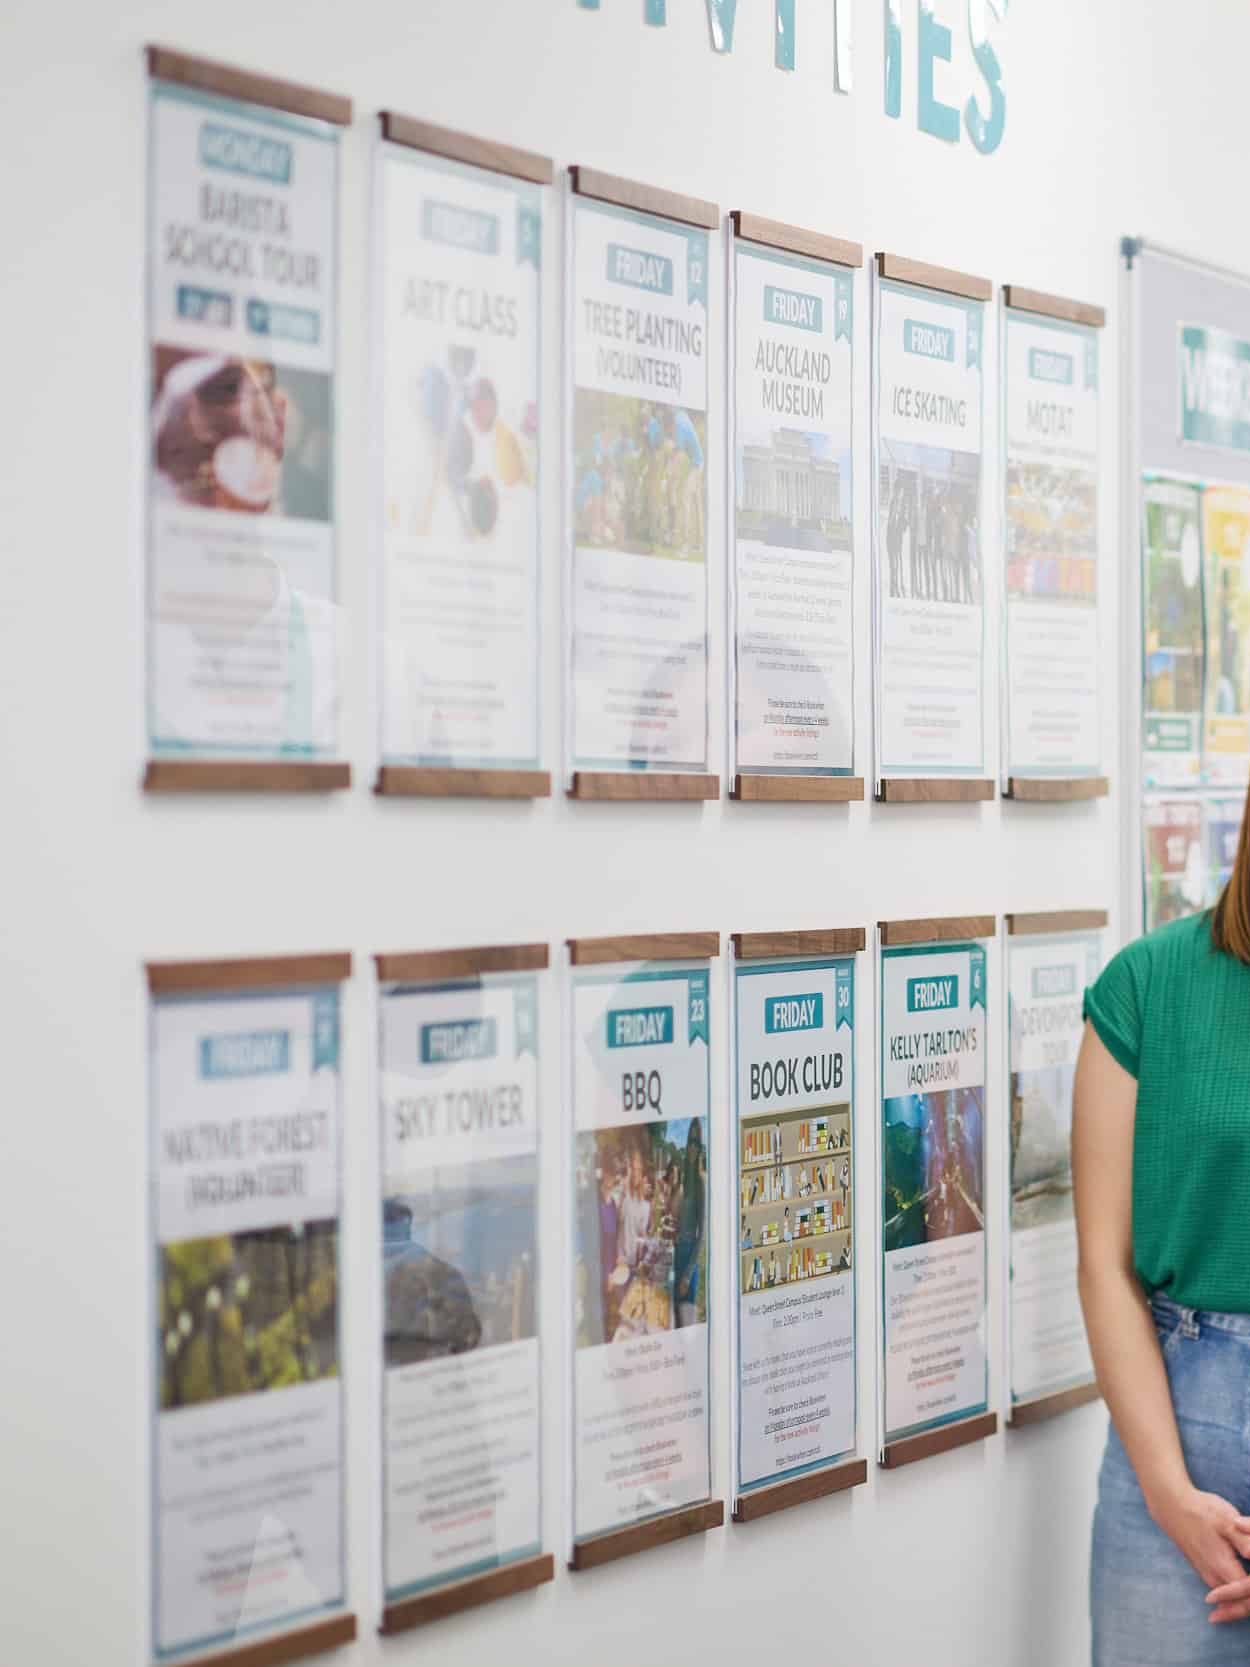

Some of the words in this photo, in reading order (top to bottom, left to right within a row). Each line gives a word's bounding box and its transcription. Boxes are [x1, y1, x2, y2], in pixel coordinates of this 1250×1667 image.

[201, 183, 289, 236] BARISTA
[164, 221, 255, 278] SCHOOL
[260, 243, 321, 290] TOUR
[615, 250, 665, 288] FRIDAY
[401, 276, 450, 325] ART
[455, 286, 518, 339] CLASS
[773, 291, 815, 326] FRIDAY
[839, 300, 848, 321] 19
[584, 299, 622, 339] TREE
[626, 309, 702, 357] PLANTING
[912, 327, 948, 358] FRIDAY
[598, 345, 682, 396] (VOLUNTEER)
[755, 337, 831, 384] AUCKLAND
[762, 378, 824, 419] MUSEUM
[892, 385, 911, 417] ICE
[914, 390, 967, 427] SKATING
[1027, 399, 1073, 436] MOTAT
[690, 999, 705, 1021] 23
[838, 986, 849, 1008] 30
[914, 980, 953, 1009] FRIDAY
[615, 1010, 666, 1045] FRIDAY
[773, 999, 816, 1030] FRIDAY
[890, 1032, 921, 1061] KELLY
[923, 1027, 978, 1056] TARLTON'S
[622, 1069, 662, 1116] BBQ
[750, 1057, 799, 1101] BOOK
[803, 1052, 843, 1093] CLUB
[907, 1059, 960, 1088] (AQUARIUM)
[395, 1096, 439, 1142] SKY
[444, 1084, 524, 1136] TOWER
[165, 1119, 242, 1163] NATIVE
[249, 1111, 328, 1153] FOREST
